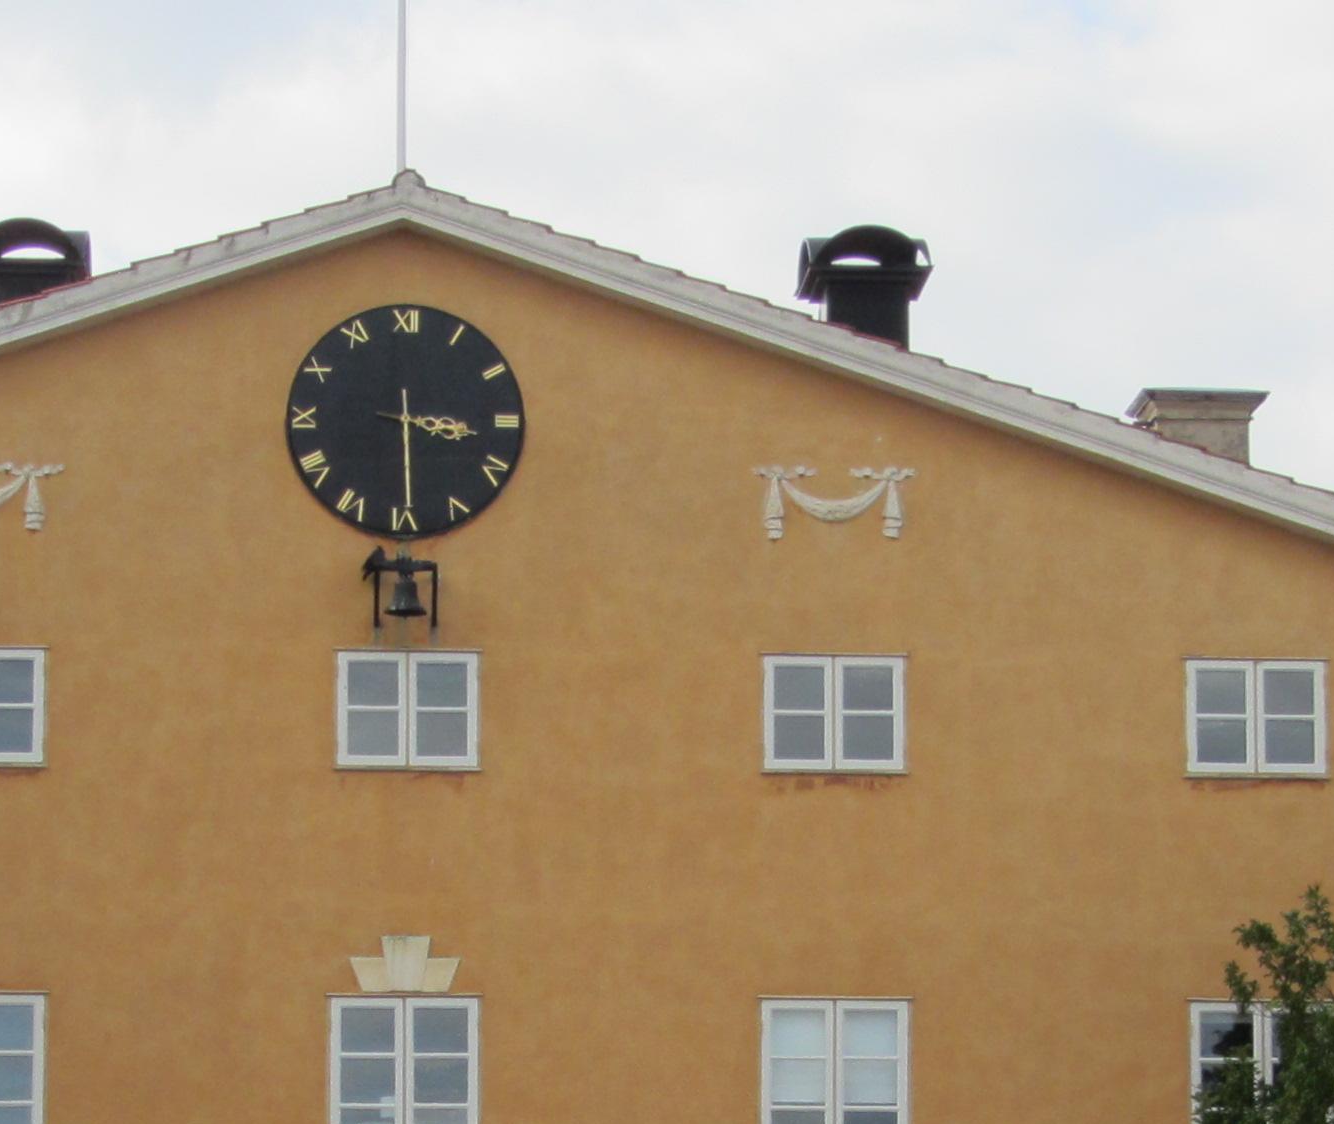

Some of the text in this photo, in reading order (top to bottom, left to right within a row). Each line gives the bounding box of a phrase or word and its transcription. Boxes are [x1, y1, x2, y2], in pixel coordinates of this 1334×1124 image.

[340, 319, 370, 349] XI
[393, 310, 419, 333] XII
[303, 356, 333, 383] X
[292, 406, 316, 428] IX
[299, 450, 330, 488] VIII
[482, 454, 510, 487] IV
[336, 488, 365, 522] VII
[448, 496, 470, 521] V
[392, 507, 419, 531] VI
